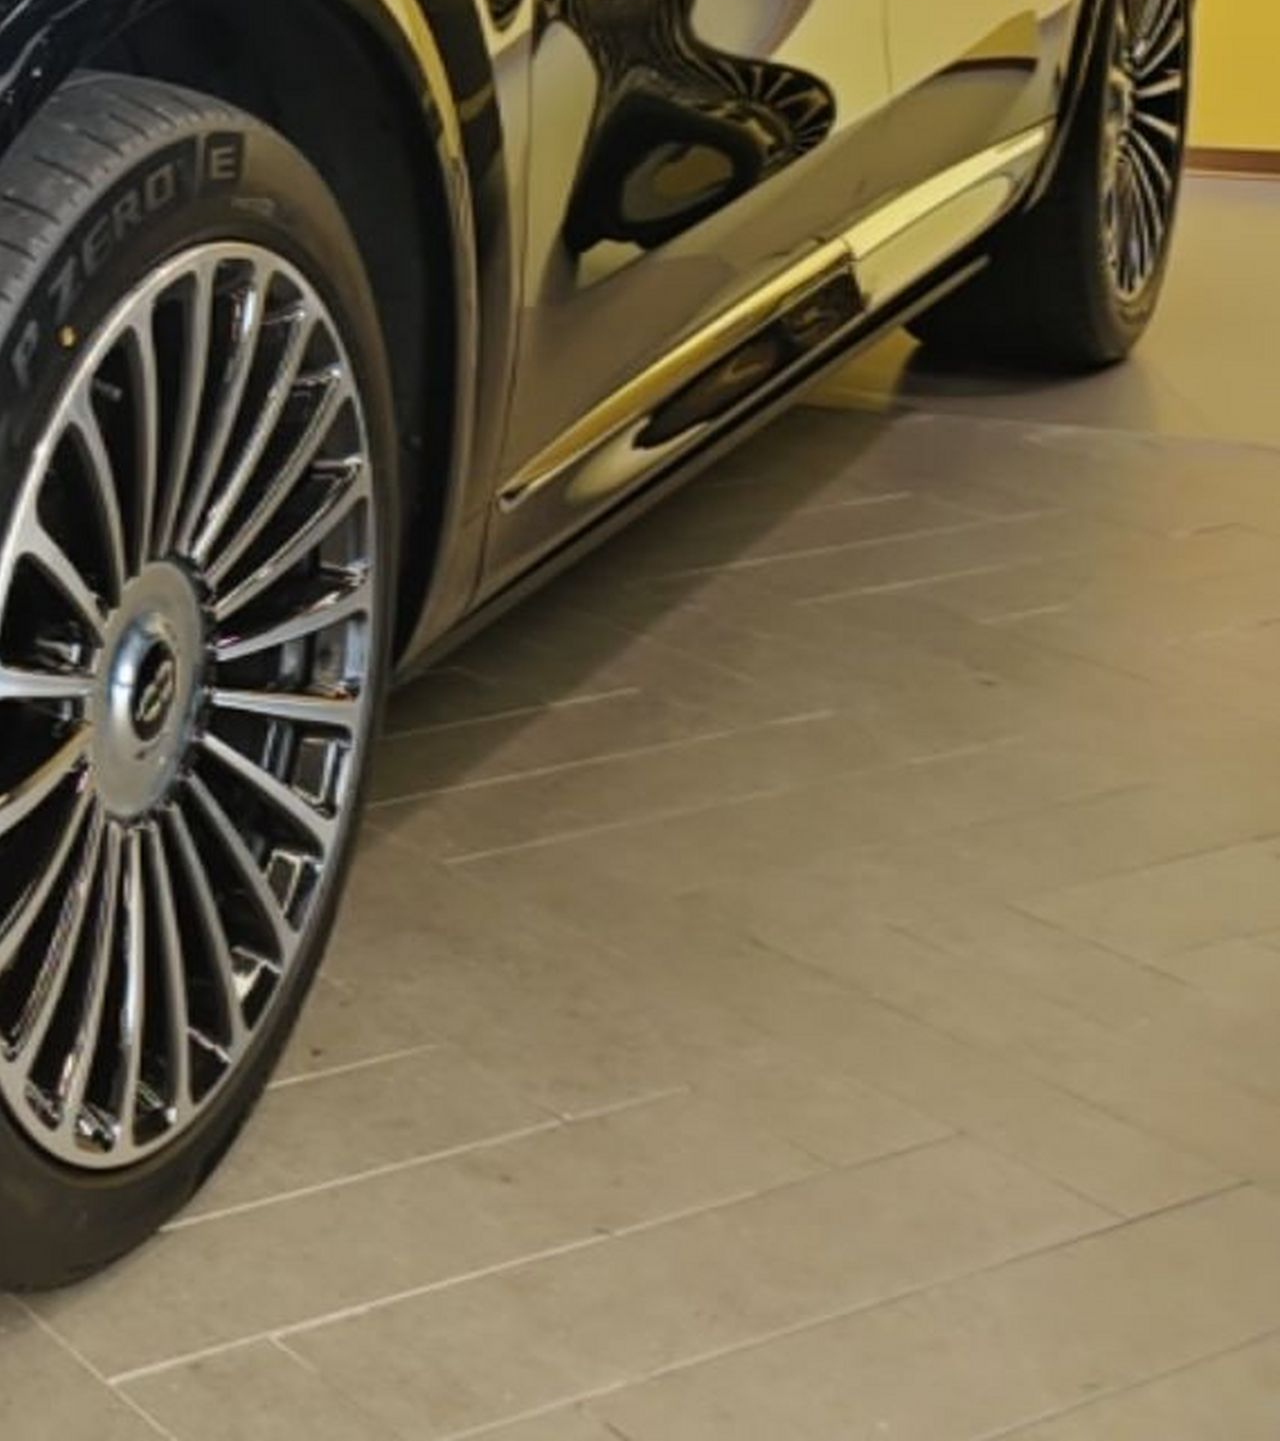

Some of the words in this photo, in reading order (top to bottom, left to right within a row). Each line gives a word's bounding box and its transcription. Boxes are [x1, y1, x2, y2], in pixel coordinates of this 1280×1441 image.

[11, 319, 39, 389] P
[47, 162, 178, 322] ZERO
[210, 145, 238, 181] E
